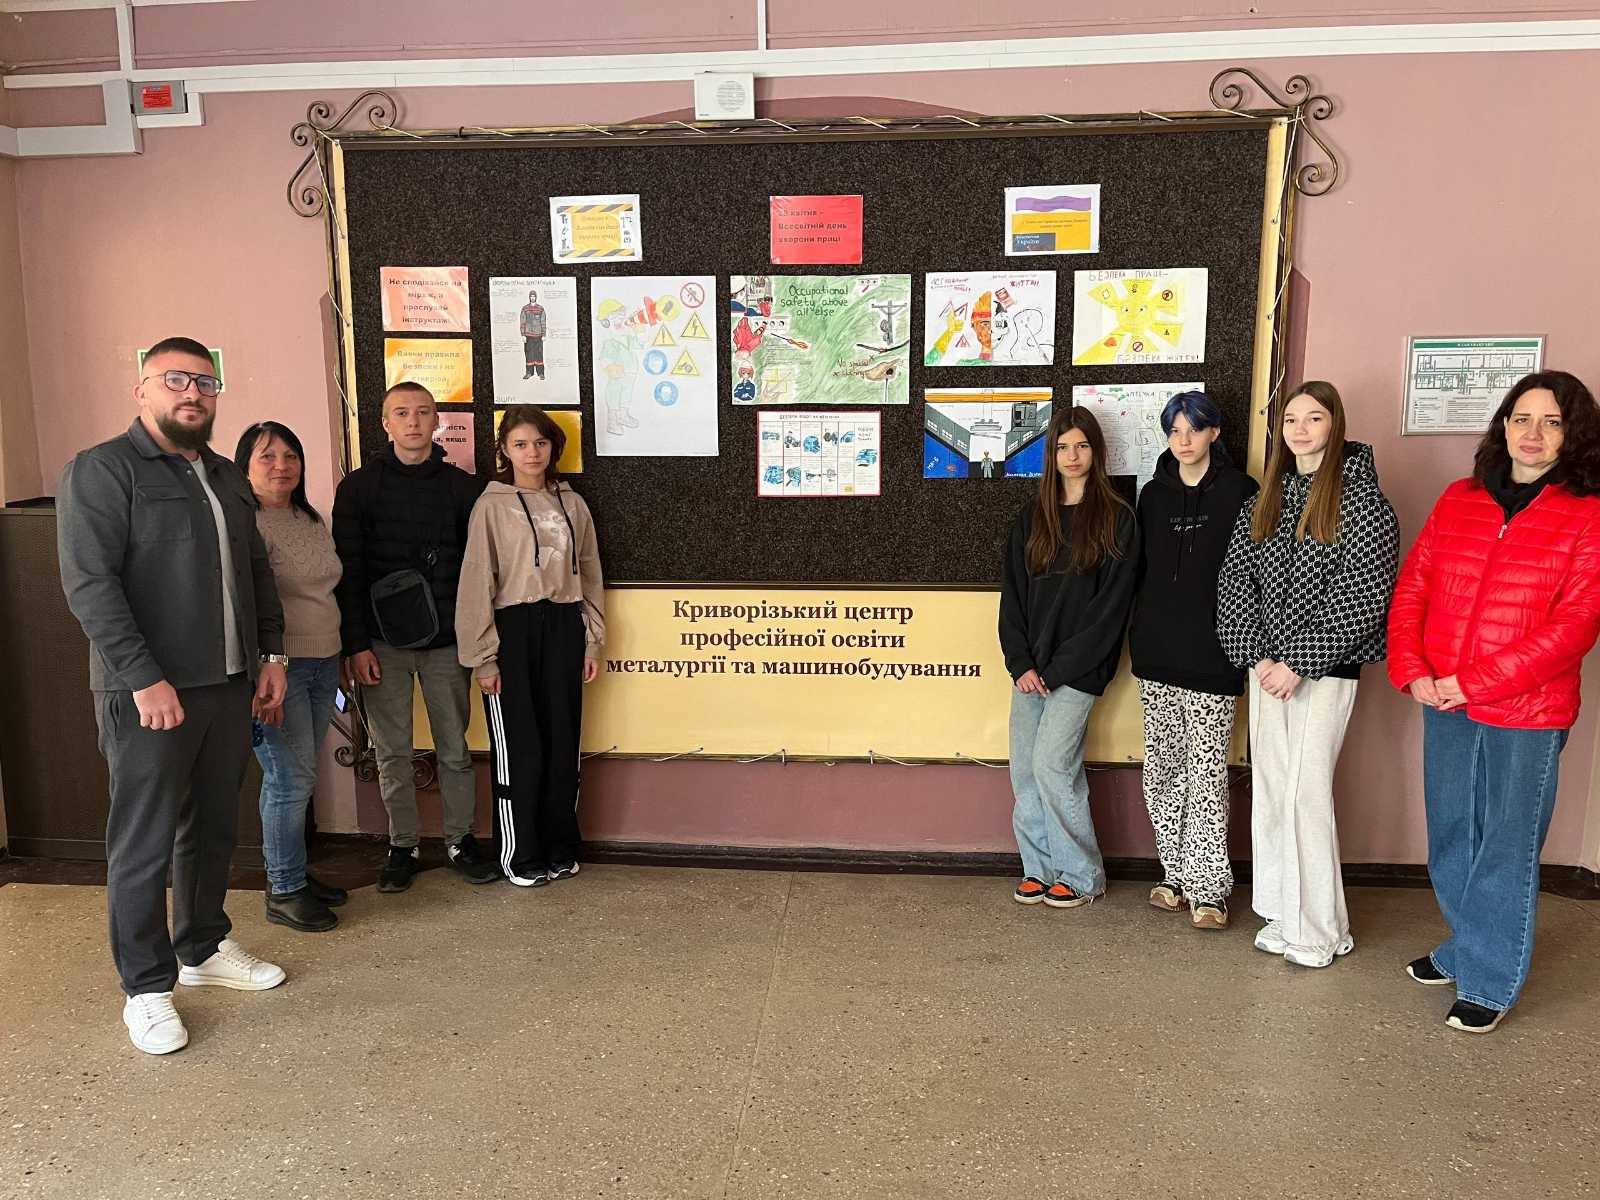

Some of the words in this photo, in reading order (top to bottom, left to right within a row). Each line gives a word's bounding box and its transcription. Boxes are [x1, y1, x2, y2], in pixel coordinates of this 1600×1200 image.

[788, 284, 849, 296] Occupational
[780, 296, 816, 308] safety
[821, 297, 849, 307] above
[815, 306, 835, 316] else
[425, 351, 461, 359] правила
[672, 599, 838, 623] Криворізький
[844, 606, 914, 625] центр
[680, 628, 827, 650] професійної
[831, 629, 906, 648] освіти
[606, 655, 727, 678] металургії
[731, 661, 756, 674] та
[762, 657, 982, 681] машинобудування
